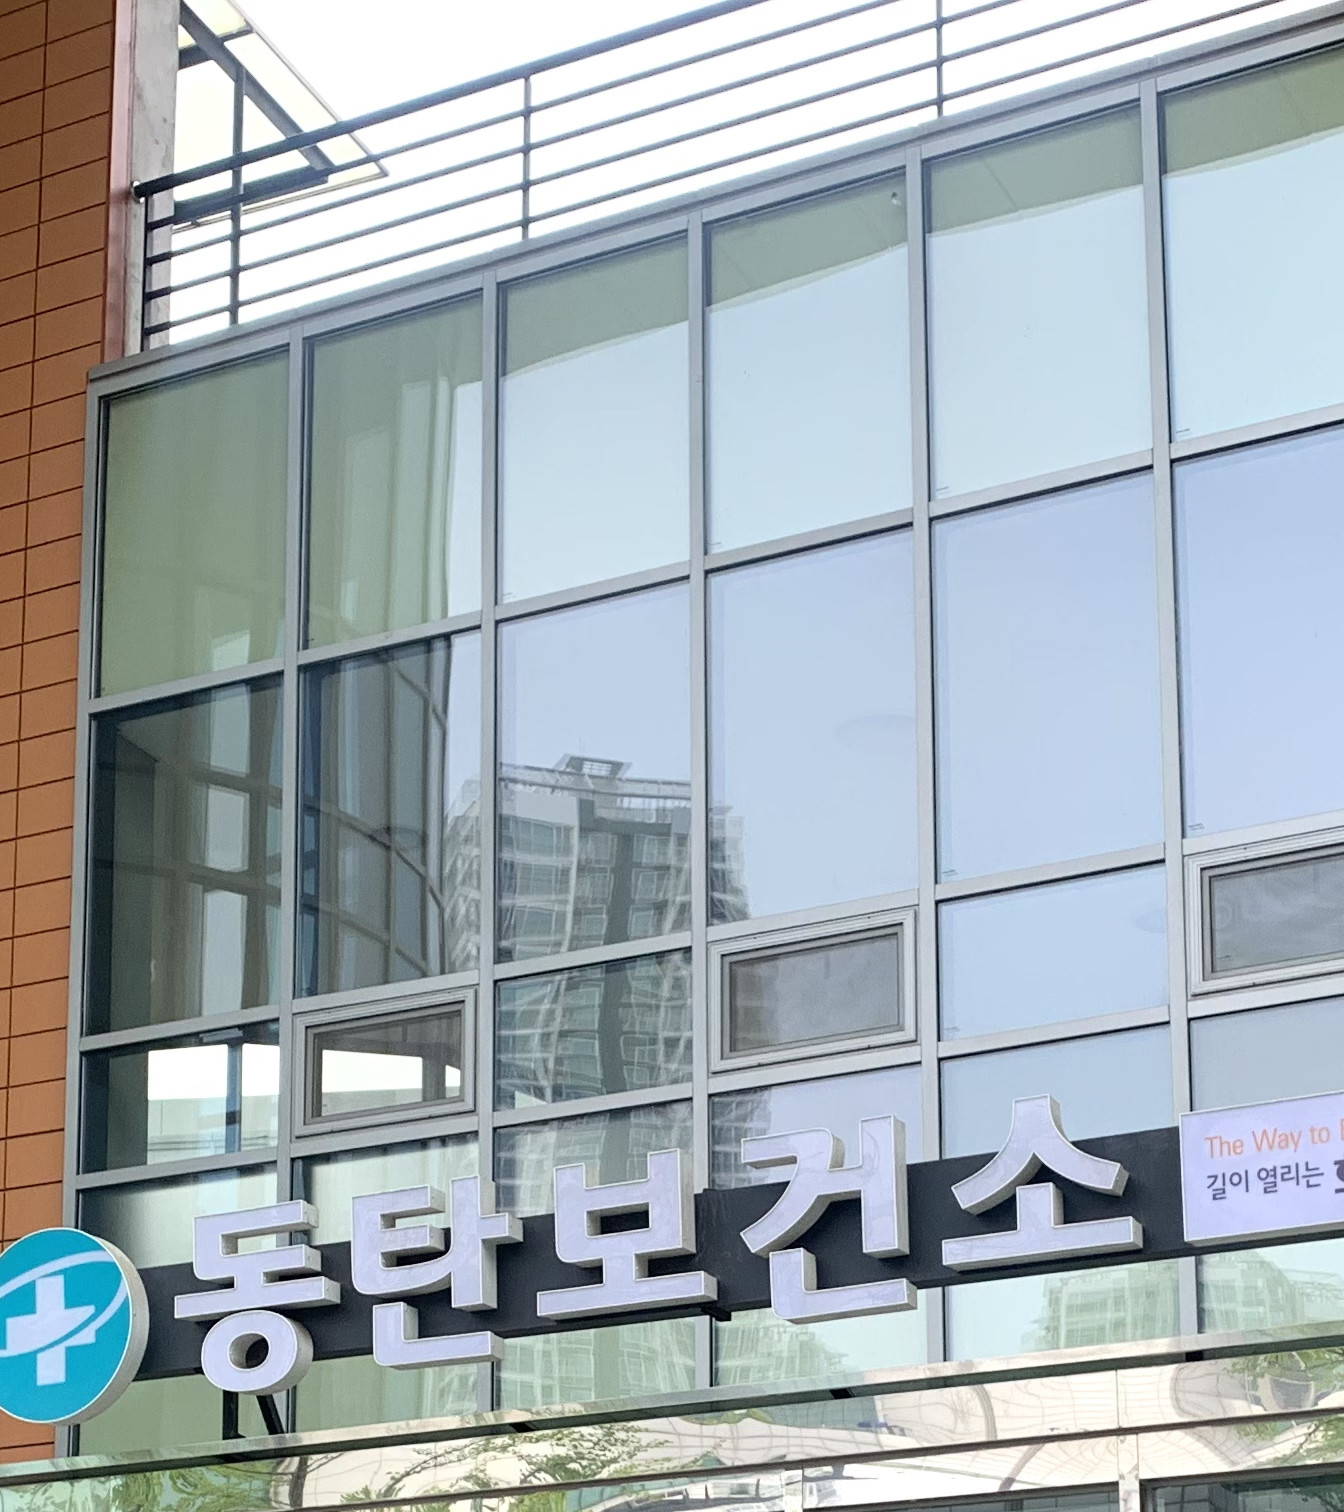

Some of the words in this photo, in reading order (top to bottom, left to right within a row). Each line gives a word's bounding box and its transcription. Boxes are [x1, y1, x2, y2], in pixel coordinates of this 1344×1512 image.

[1205, 1133, 1244, 1160] The
[1252, 1126, 1304, 1159] Way
[1310, 1122, 1332, 1145] to
[1206, 1166, 1251, 1201] 길이
[1256, 1161, 1325, 1196] 열리는
[174, 1094, 1143, 1396] 동탄보건소
